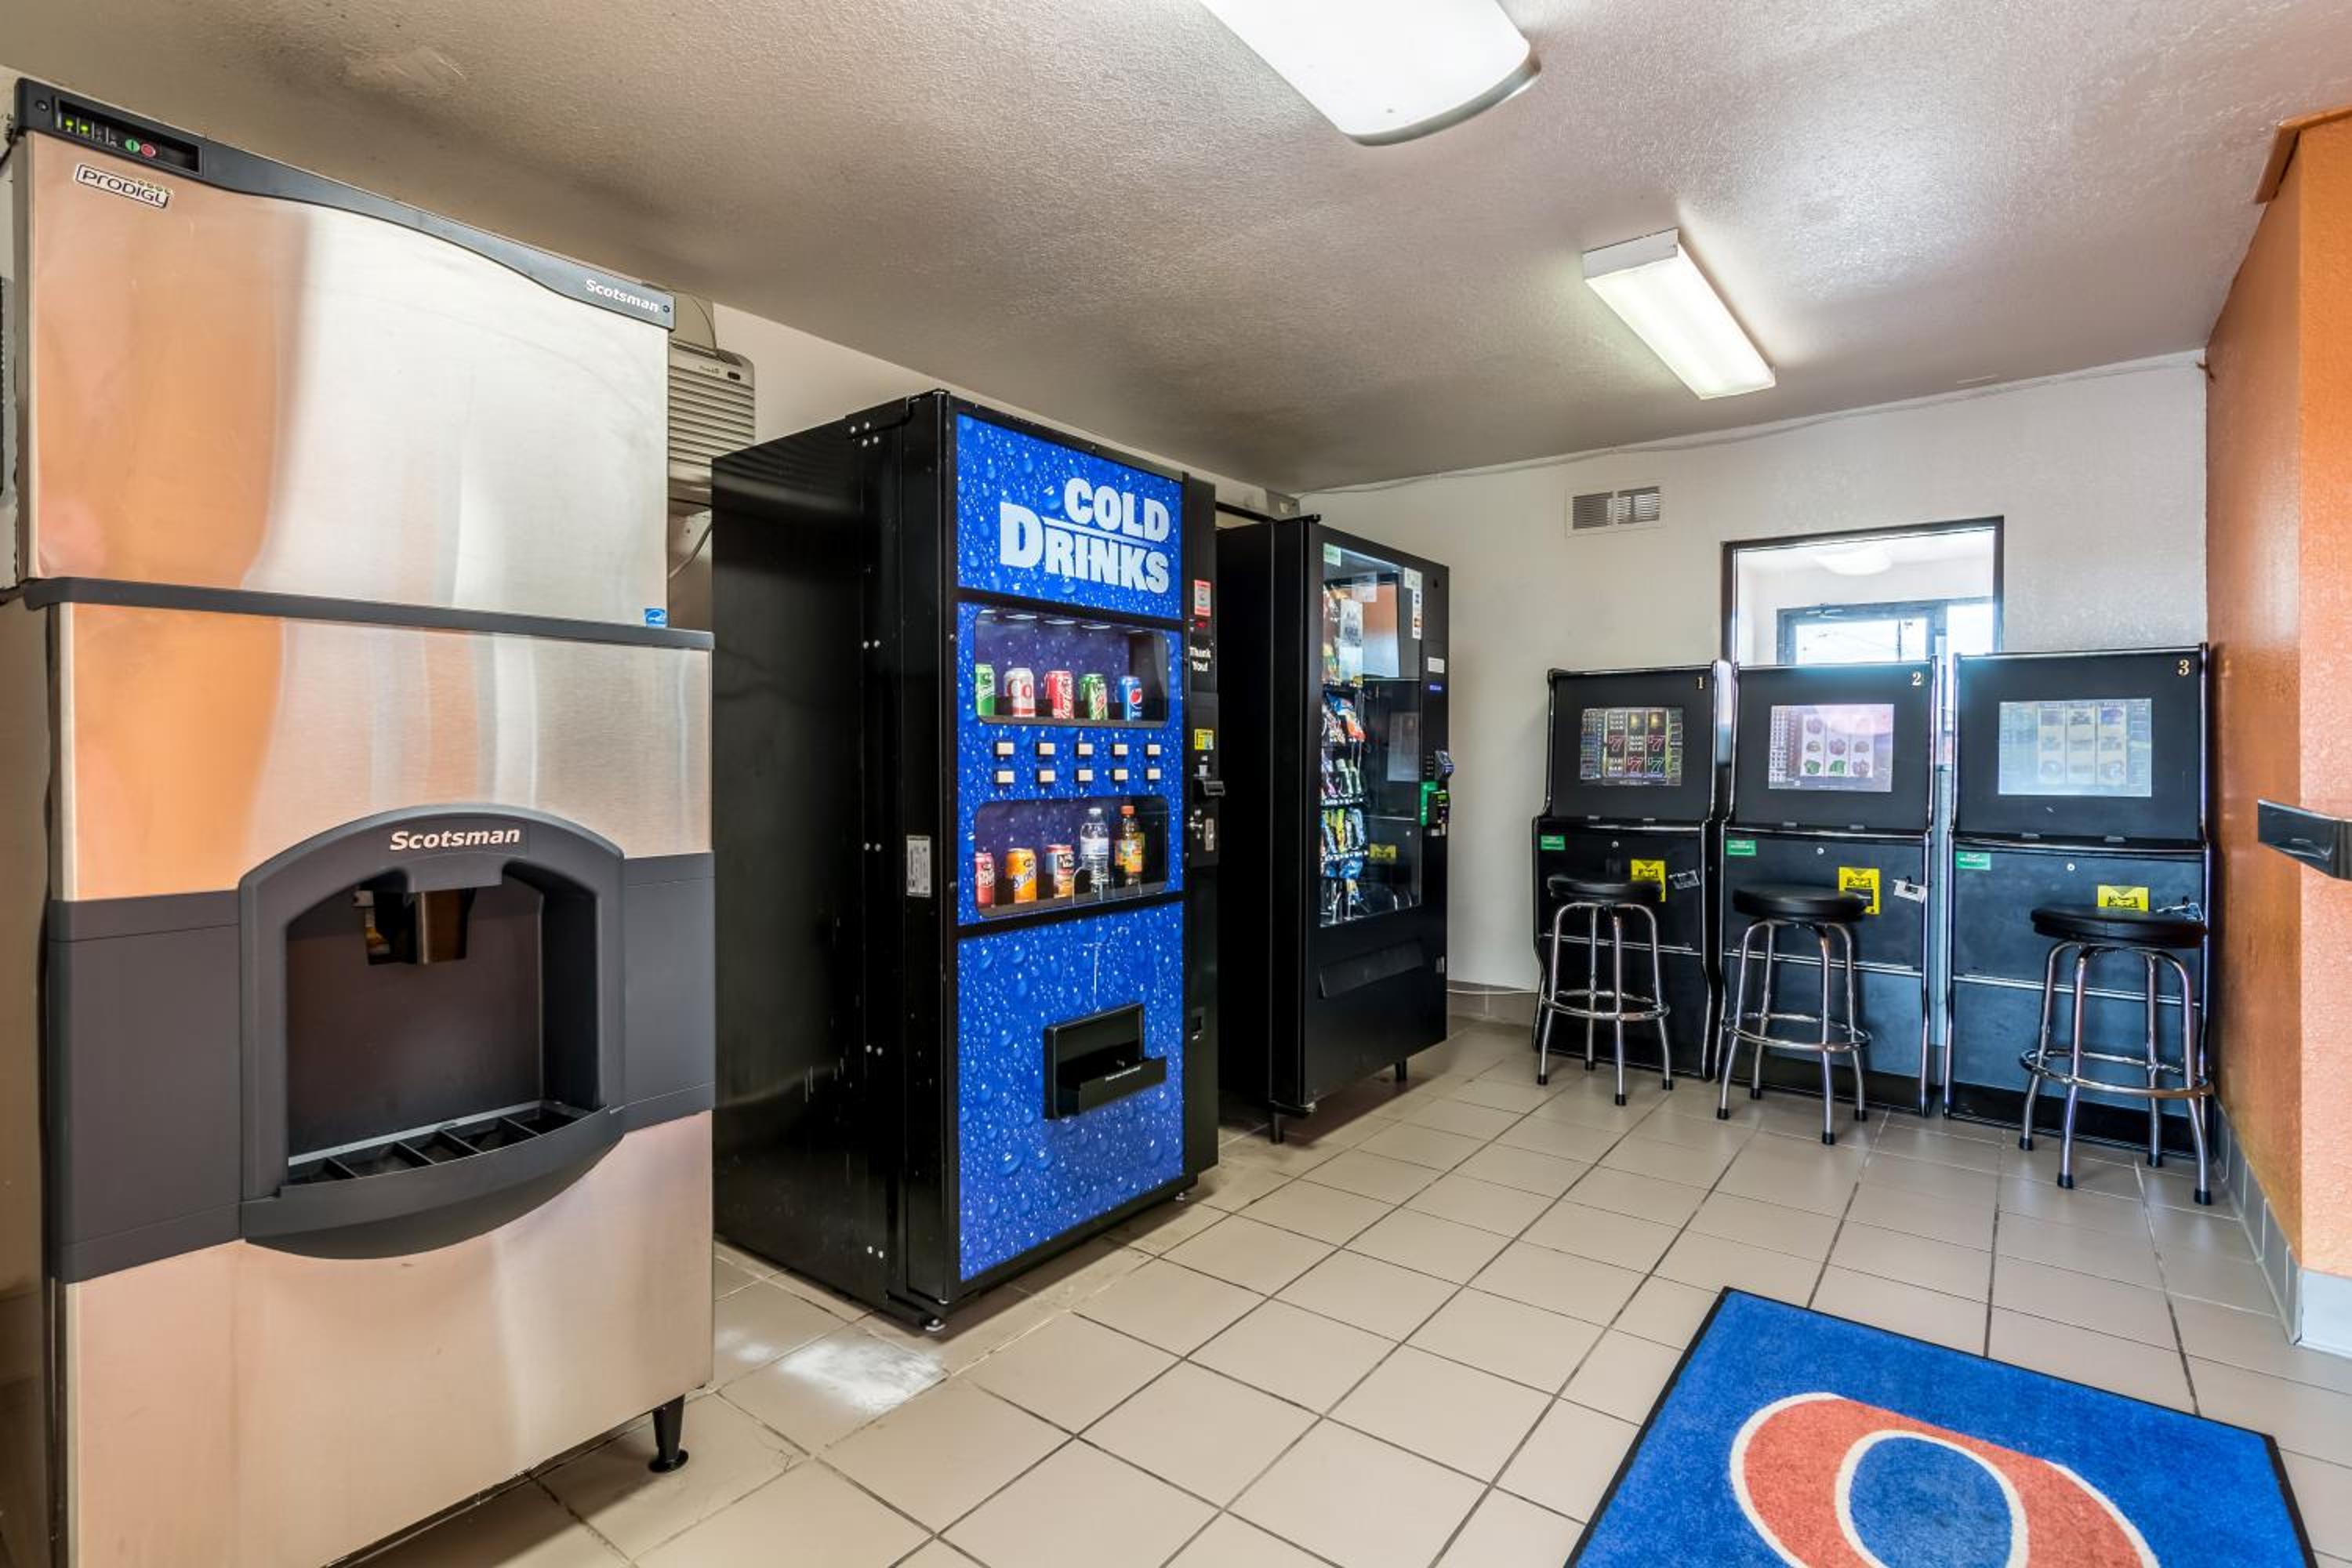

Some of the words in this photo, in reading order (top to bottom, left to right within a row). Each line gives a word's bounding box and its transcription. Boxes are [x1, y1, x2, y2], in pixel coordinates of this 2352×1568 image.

[586, 278, 659, 313] Scotsman
[1064, 477, 1170, 543] COLD
[1000, 501, 1169, 594] DRINKS
[2177, 659, 2190, 677] 3
[1697, 677, 1704, 689] 1
[1911, 672, 1922, 687] 2
[1609, 735, 1624, 752] 7
[1648, 735, 1664, 752] 7
[1628, 757, 1643, 774] 7
[1648, 757, 1664, 774] 7
[389, 829, 521, 851] Scotsman
